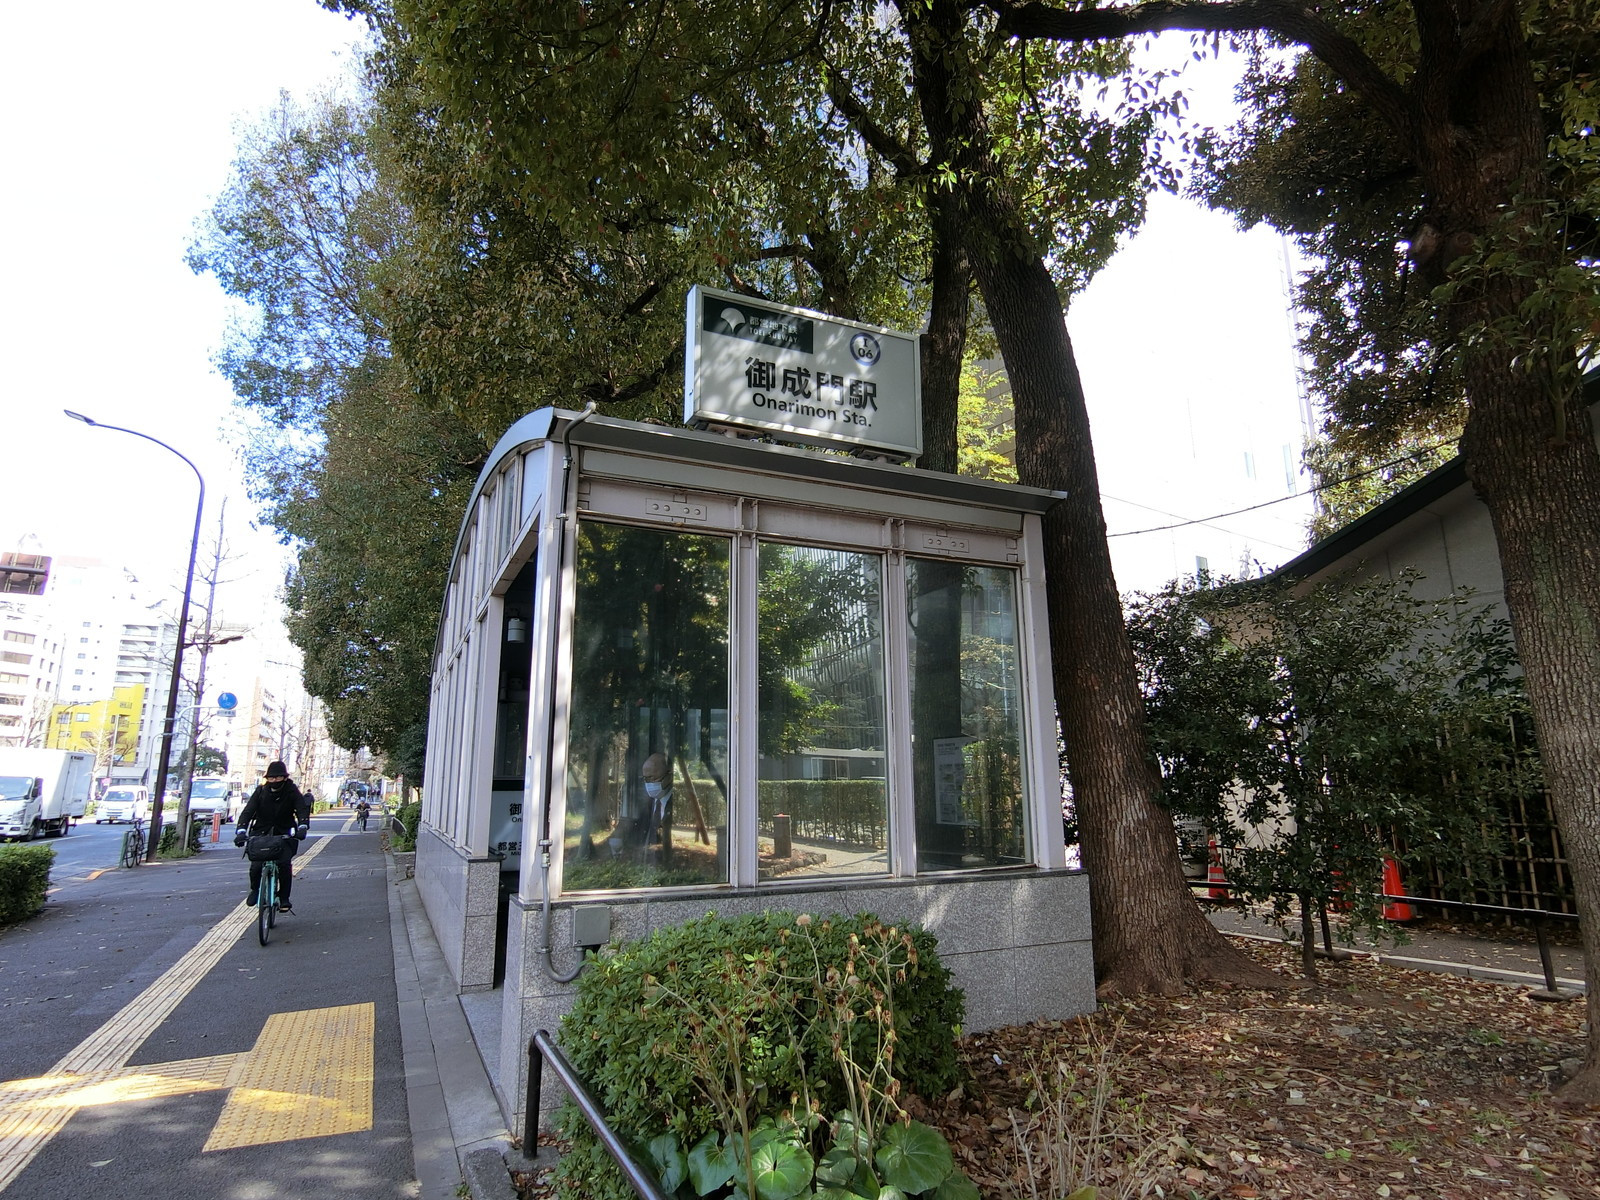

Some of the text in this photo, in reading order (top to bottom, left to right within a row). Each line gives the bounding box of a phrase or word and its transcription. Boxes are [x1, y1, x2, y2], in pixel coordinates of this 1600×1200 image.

[749, 316, 798, 335] 都営地下鉄
[750, 327, 798, 343] TOEI SUBWAY
[858, 347, 873, 359] 06
[745, 356, 878, 412] 御成門駅
[752, 392, 872, 427] Onarimon Sta.
